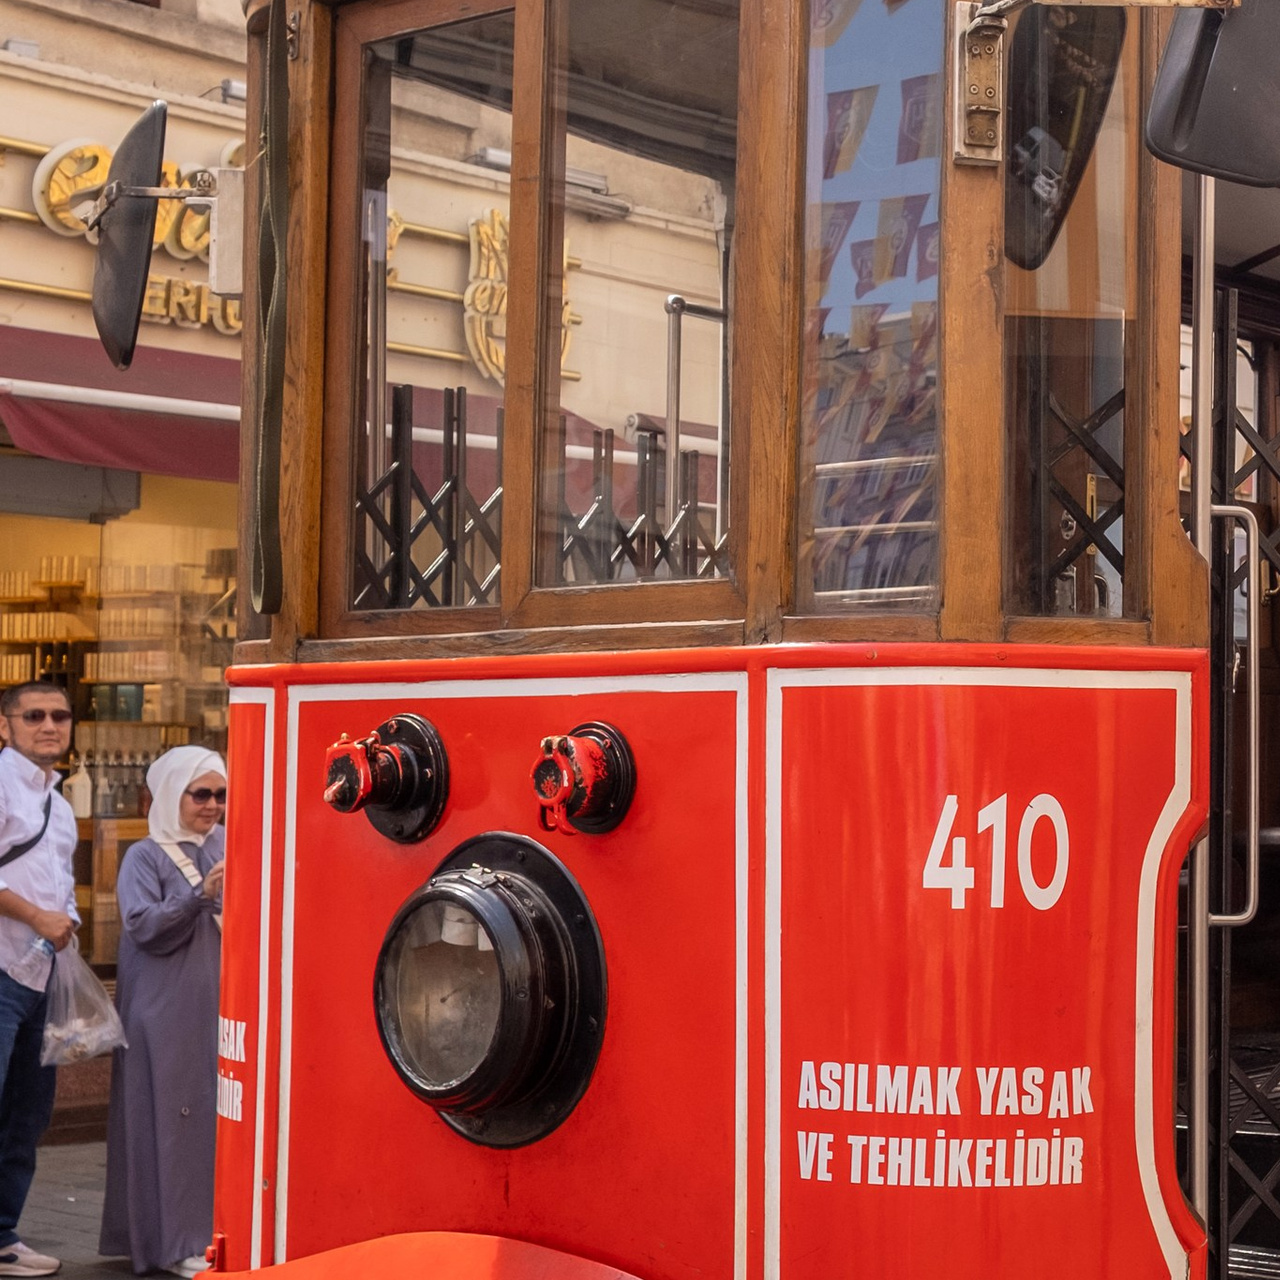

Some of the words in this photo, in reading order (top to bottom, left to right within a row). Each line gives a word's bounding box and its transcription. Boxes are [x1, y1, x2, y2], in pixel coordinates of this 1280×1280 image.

[922, 792, 1070, 910] 410
[797, 1060, 962, 1116] ASILMAK
[975, 1065, 1095, 1119] YASAK
[796, 1130, 835, 1182] VE
[846, 1128, 1084, 1188] TEHLİKELİDİR
